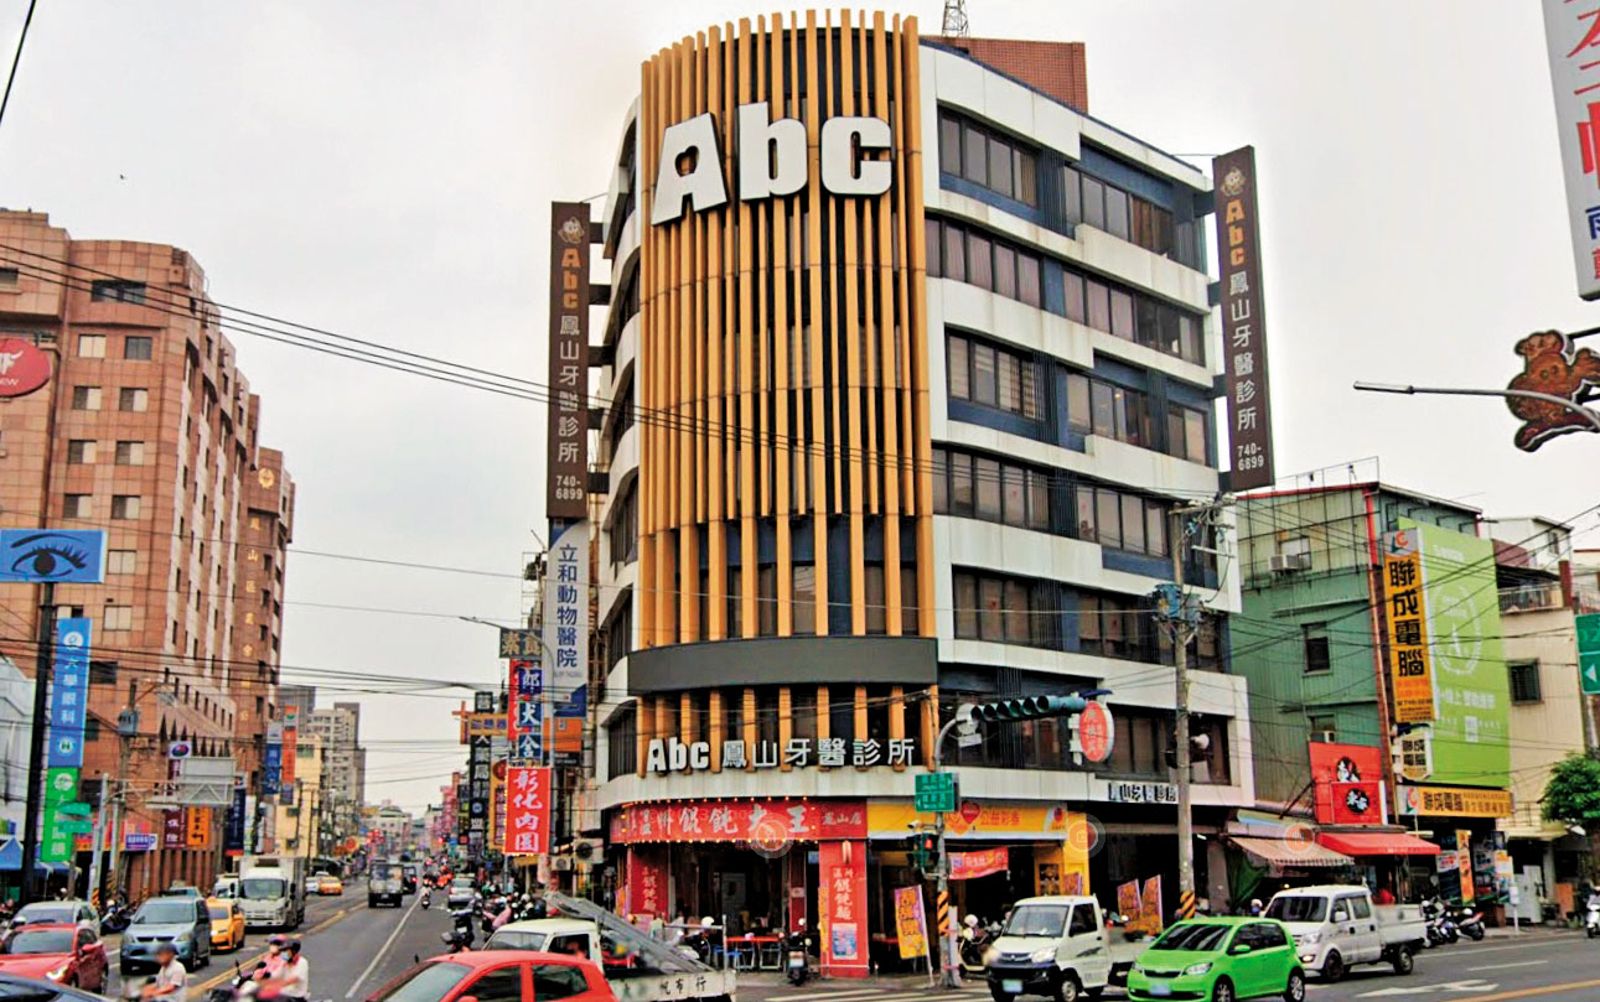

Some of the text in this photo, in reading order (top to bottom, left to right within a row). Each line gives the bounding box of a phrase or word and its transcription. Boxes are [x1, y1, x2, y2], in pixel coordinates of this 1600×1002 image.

[651, 101, 892, 226] Abc
[561, 247, 581, 309] Abc
[1226, 199, 1257, 431] Abc 鳳山牙醫診所
[556, 488, 583, 500] 6899
[1238, 456, 1264, 471] 6899
[556, 543, 578, 668] 立和動物醫院
[1389, 559, 1425, 677] 聯成電腦
[647, 737, 916, 772] Abc 鳳山牙醫診所
